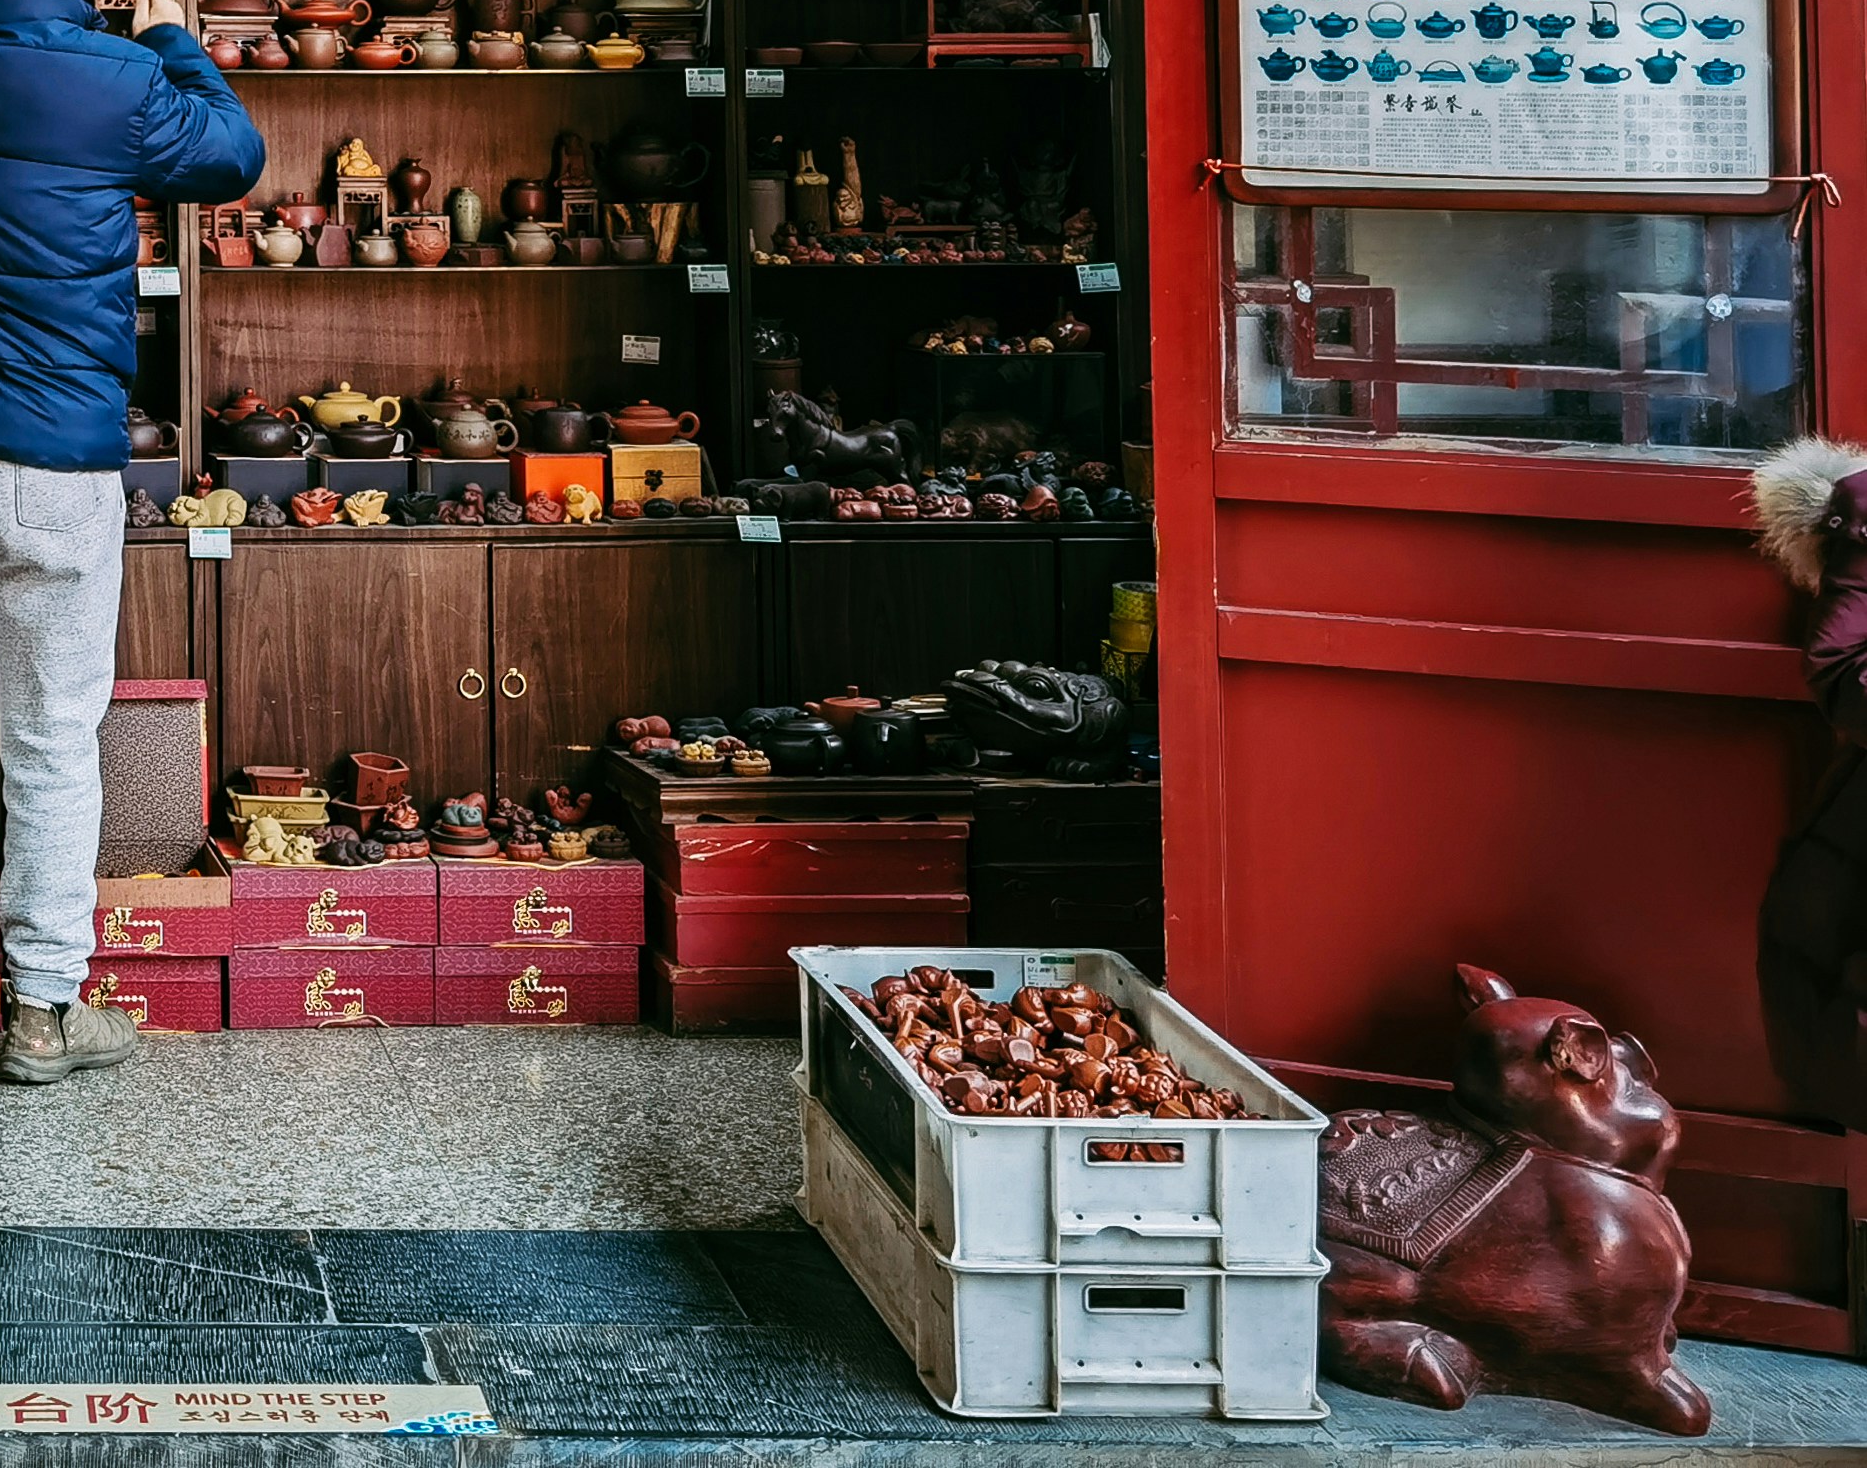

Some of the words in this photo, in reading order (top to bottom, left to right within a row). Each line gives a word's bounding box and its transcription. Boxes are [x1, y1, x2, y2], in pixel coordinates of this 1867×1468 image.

[175, 1393, 251, 1405] MIND
[257, 1393, 314, 1405] THE
[319, 1393, 386, 1405] STEP
[179, 1410, 321, 1423] 조심스러운
